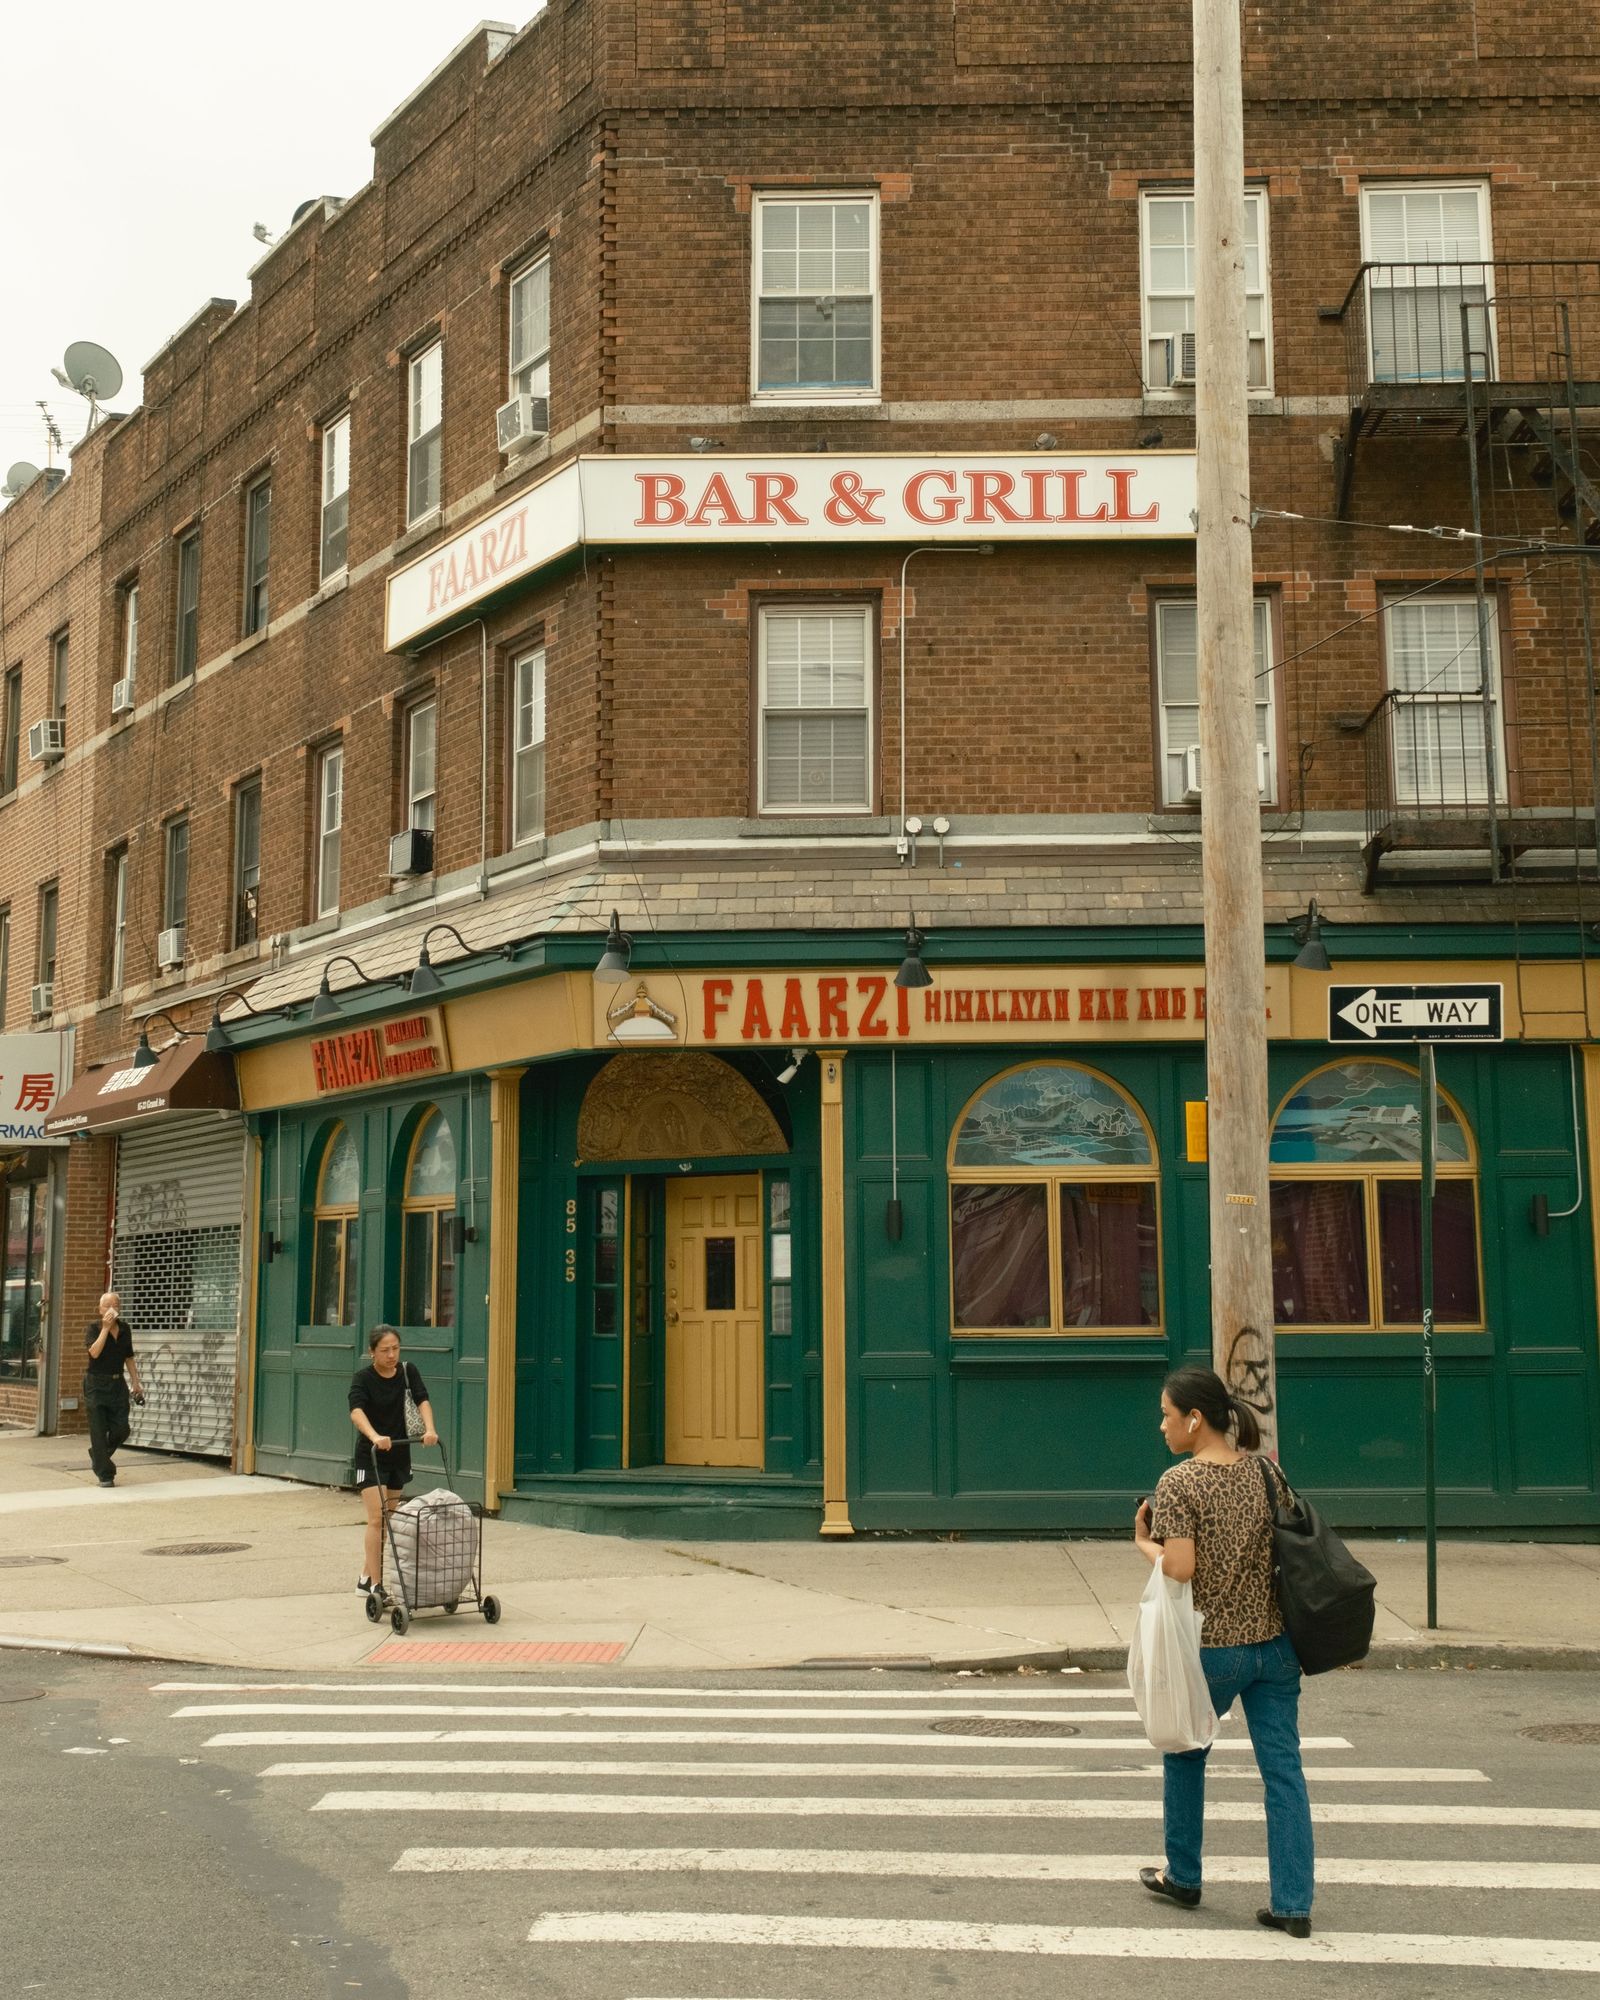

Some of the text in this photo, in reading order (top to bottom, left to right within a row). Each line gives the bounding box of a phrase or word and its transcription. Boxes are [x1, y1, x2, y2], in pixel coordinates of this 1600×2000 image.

[634, 468, 1160, 527] BAR & GRILL
[426, 505, 529, 615] FAARZI
[702, 976, 911, 1040] FAARZI
[924, 989, 1070, 1022] HIMALAYAN
[1078, 988, 1129, 1021] BAR
[1137, 987, 1187, 1021] AND
[1355, 1001, 1478, 1024] ONE WAY
[311, 1028, 384, 1091] FAARZI
[0, 1073, 55, 1112] 房
